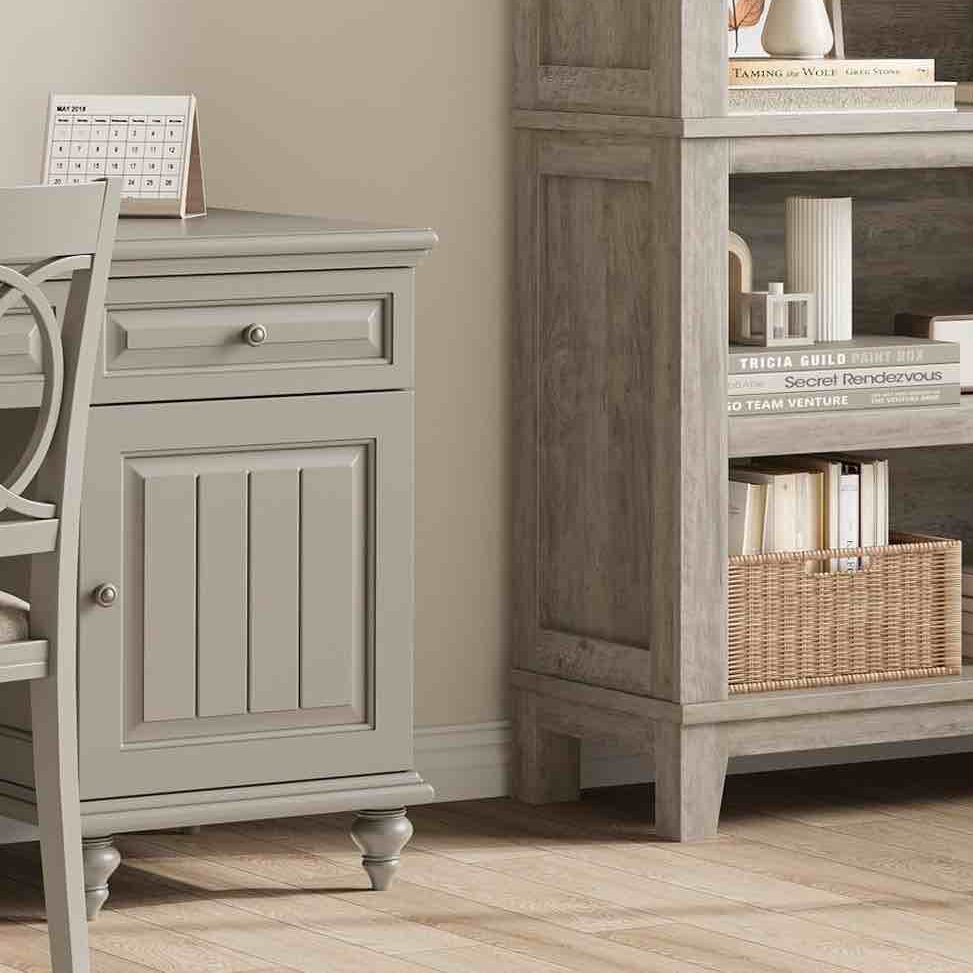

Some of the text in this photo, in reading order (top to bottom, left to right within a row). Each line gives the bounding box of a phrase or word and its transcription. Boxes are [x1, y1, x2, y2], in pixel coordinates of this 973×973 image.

[733, 66, 783, 78] TAMING
[801, 66, 837, 76] WOLF
[740, 355, 793, 370] TRICIA
[800, 353, 846, 367] GUILD
[784, 370, 943, 388] Secret Rendezvous
[746, 398, 784, 410] TEAM
[788, 395, 849, 408] VENTURE
